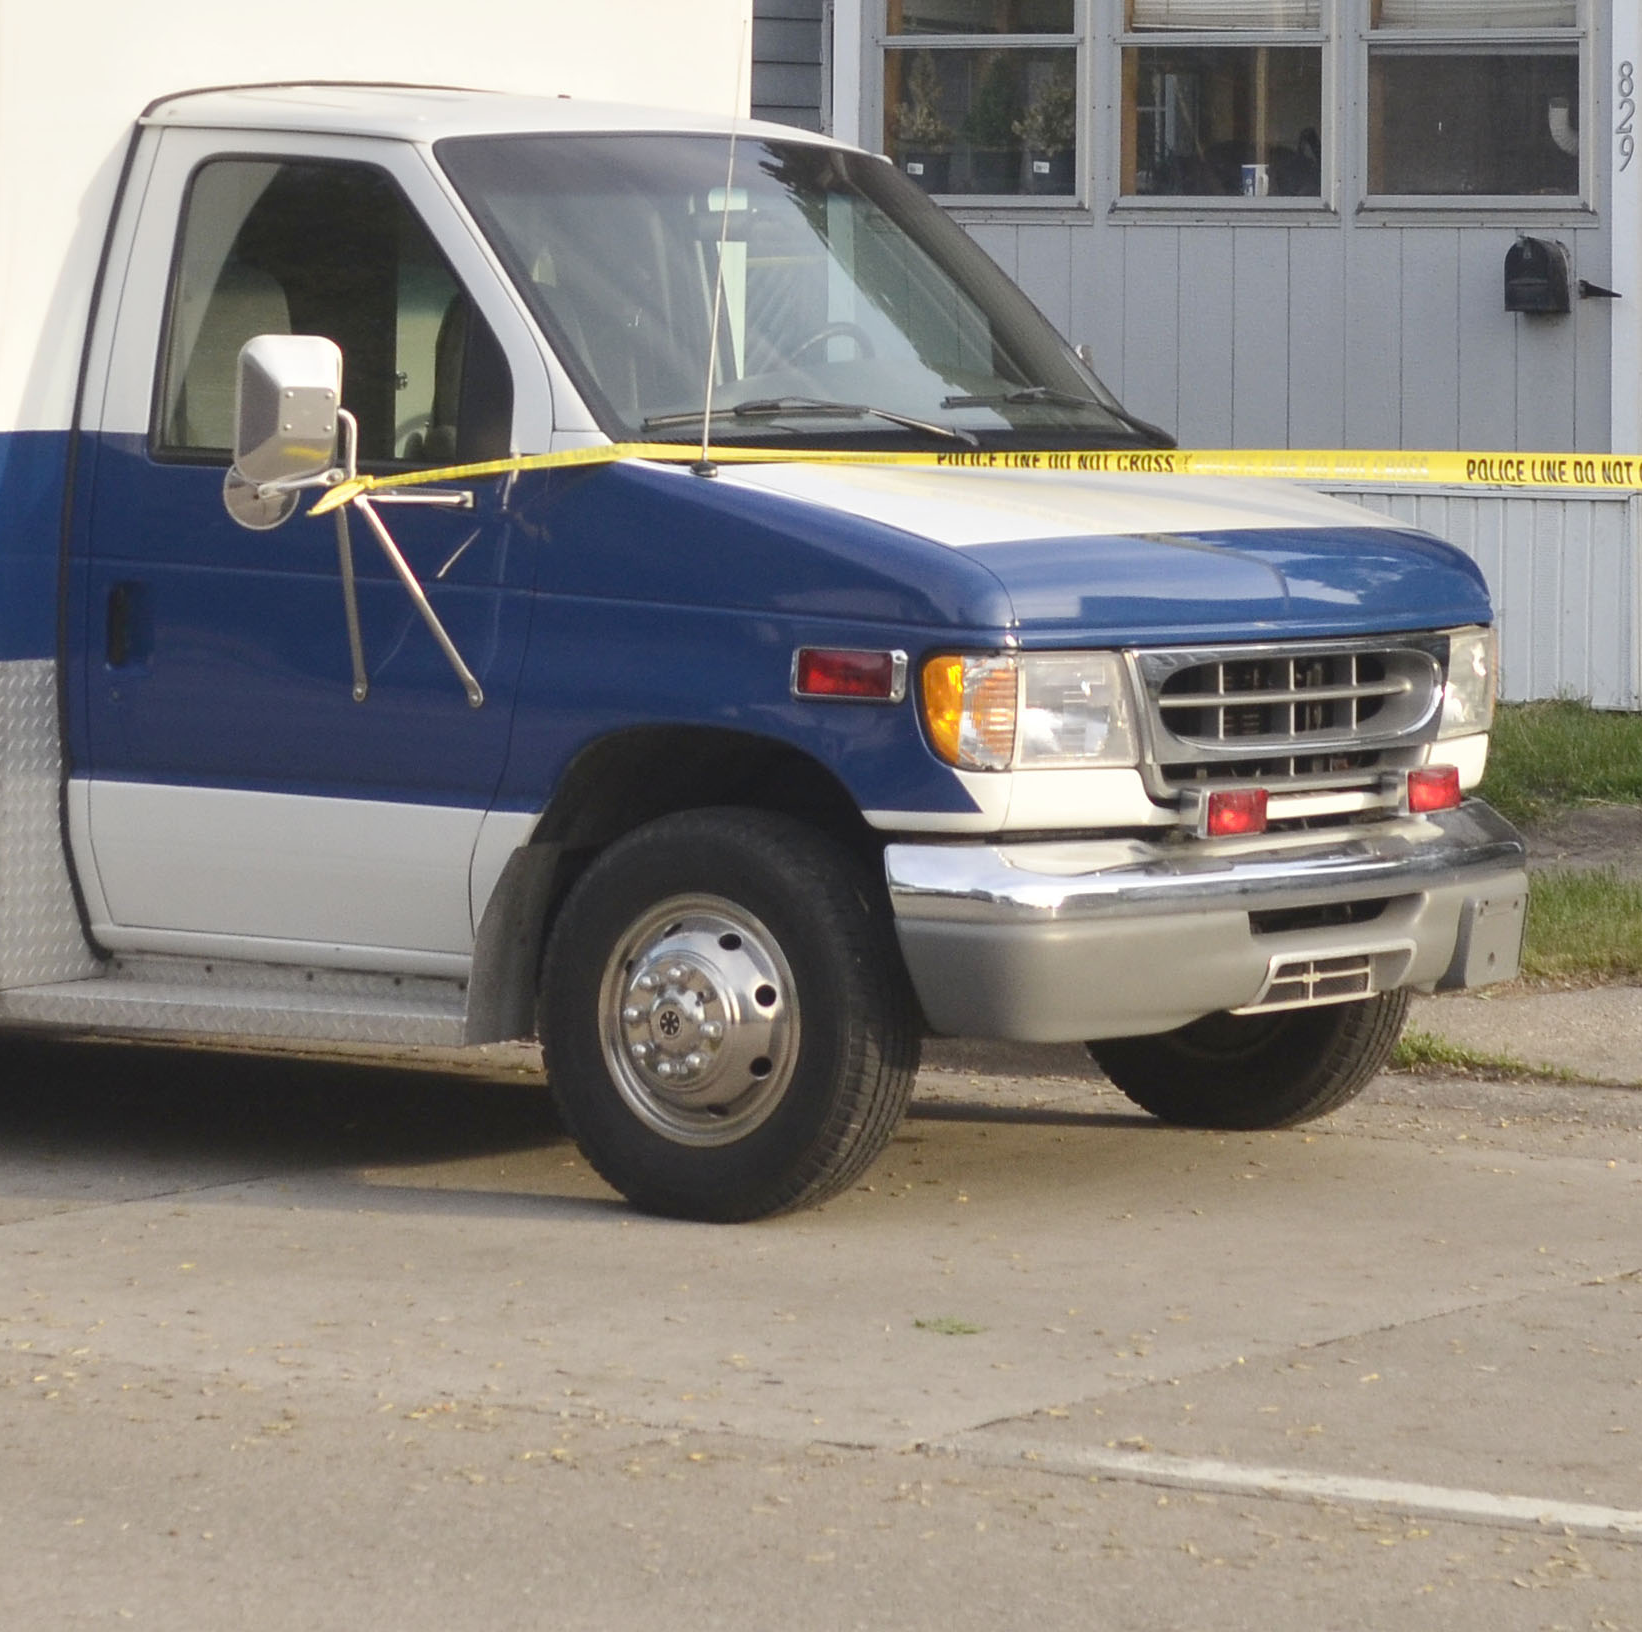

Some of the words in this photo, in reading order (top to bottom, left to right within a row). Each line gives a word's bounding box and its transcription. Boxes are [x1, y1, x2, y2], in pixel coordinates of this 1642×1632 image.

[1615, 60, 1636, 172] 829
[937, 452, 998, 467] POLICE
[1005, 453, 1041, 468] LINE
[1048, 454, 1072, 470] DO
[1078, 454, 1109, 471] NOT
[1117, 454, 1174, 473] CROSS
[1466, 459, 1525, 481] POLICE
[1532, 460, 1569, 483] LINE
[1574, 461, 1596, 484] DO
[1602, 461, 1633, 485] NOT
